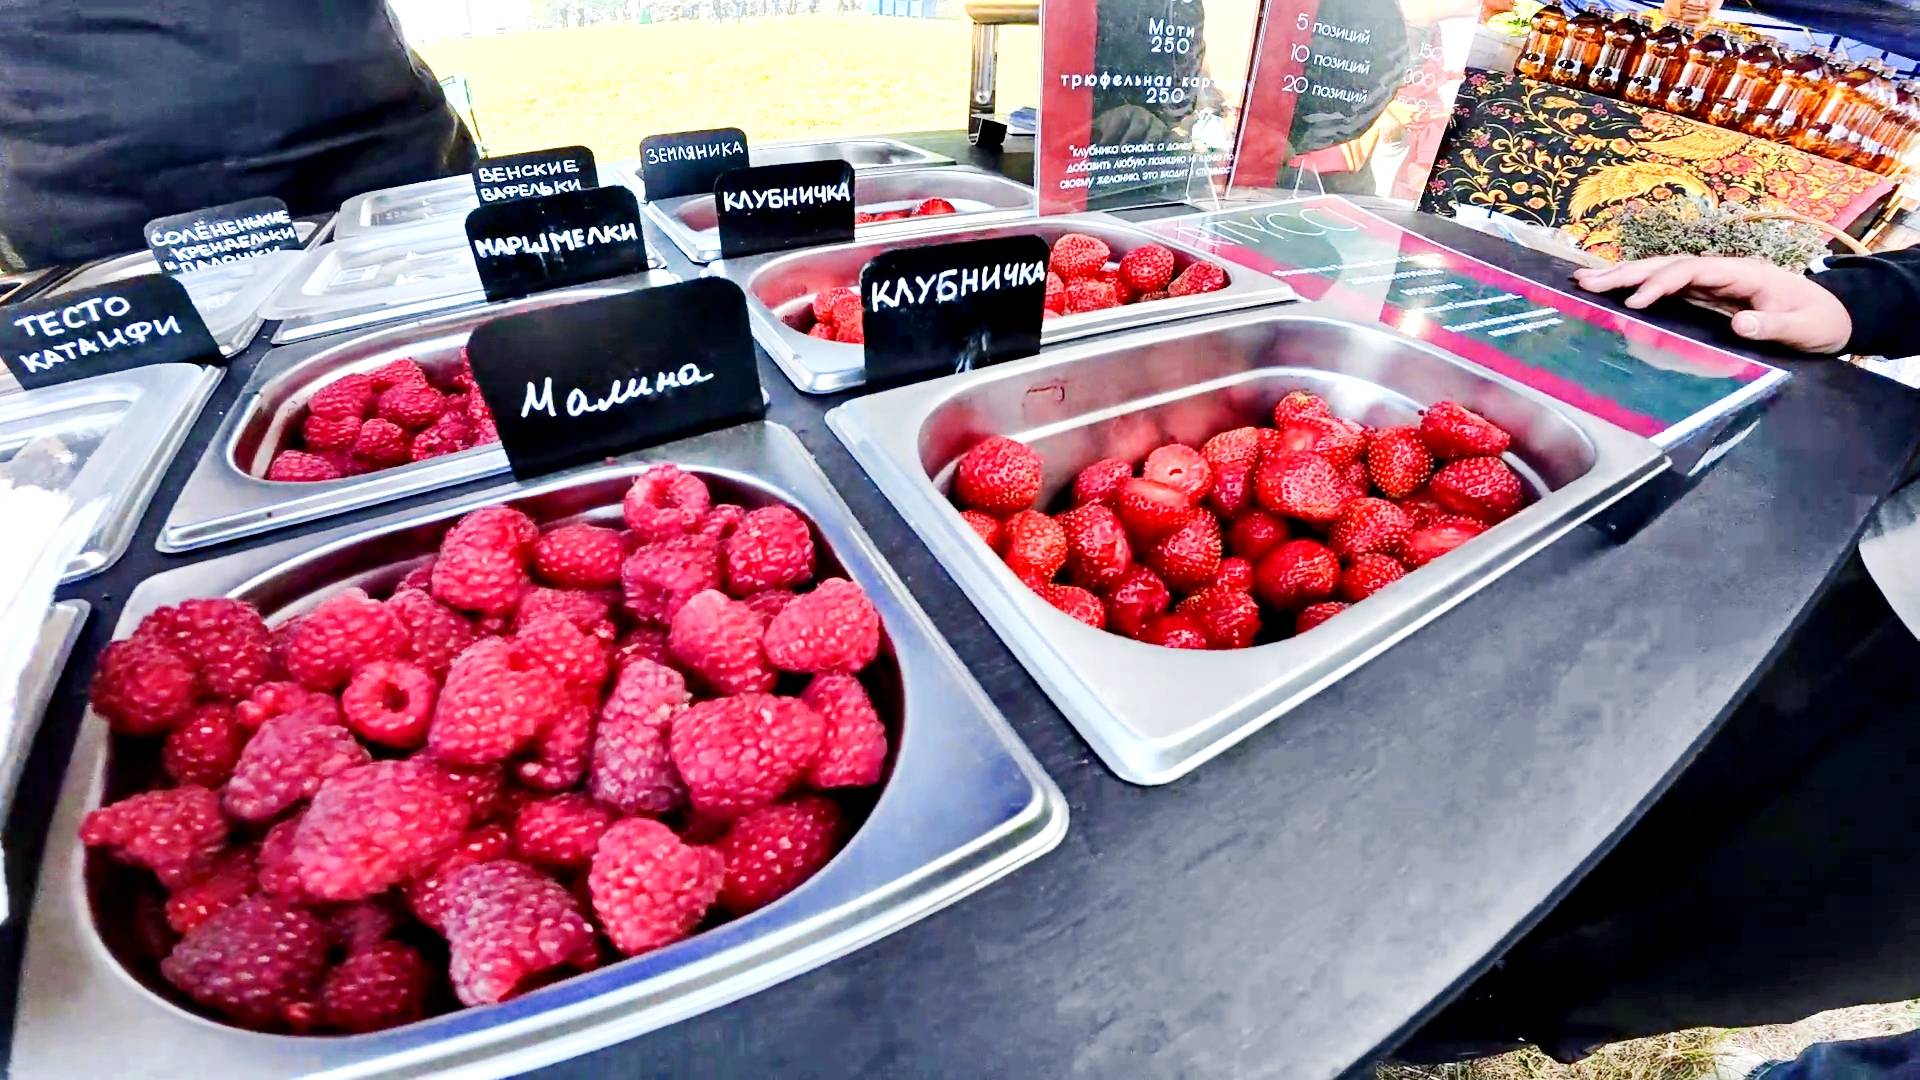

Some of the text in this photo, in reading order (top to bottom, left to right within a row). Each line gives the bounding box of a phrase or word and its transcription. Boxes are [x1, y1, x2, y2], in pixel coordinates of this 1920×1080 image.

[1149, 17, 1194, 38] Моти
[1296, 13, 1308, 30] 5
[1151, 37, 1190, 54] 250
[1291, 43, 1310, 63] 10
[1403, 68, 1436, 88] 300
[1060, 71, 1172, 90] трюфельная
[1282, 74, 1308, 93] 20
[1146, 87, 1184, 104] 250
[645, 140, 744, 165] ЗЕМЛЯНИКА
[1113, 156, 1147, 169] любую
[478, 159, 580, 183] ВЕНСКИЕ
[480, 178, 582, 202] ВАФЕЛЬКИ
[723, 183, 851, 212] КЛУБНИЧКА
[474, 222, 639, 259] МАРШМЕЛКИ
[871, 260, 1046, 312] КЛУБНИЧКА
[14, 296, 131, 337] ТЕСТО
[520, 362, 715, 418] Малина
